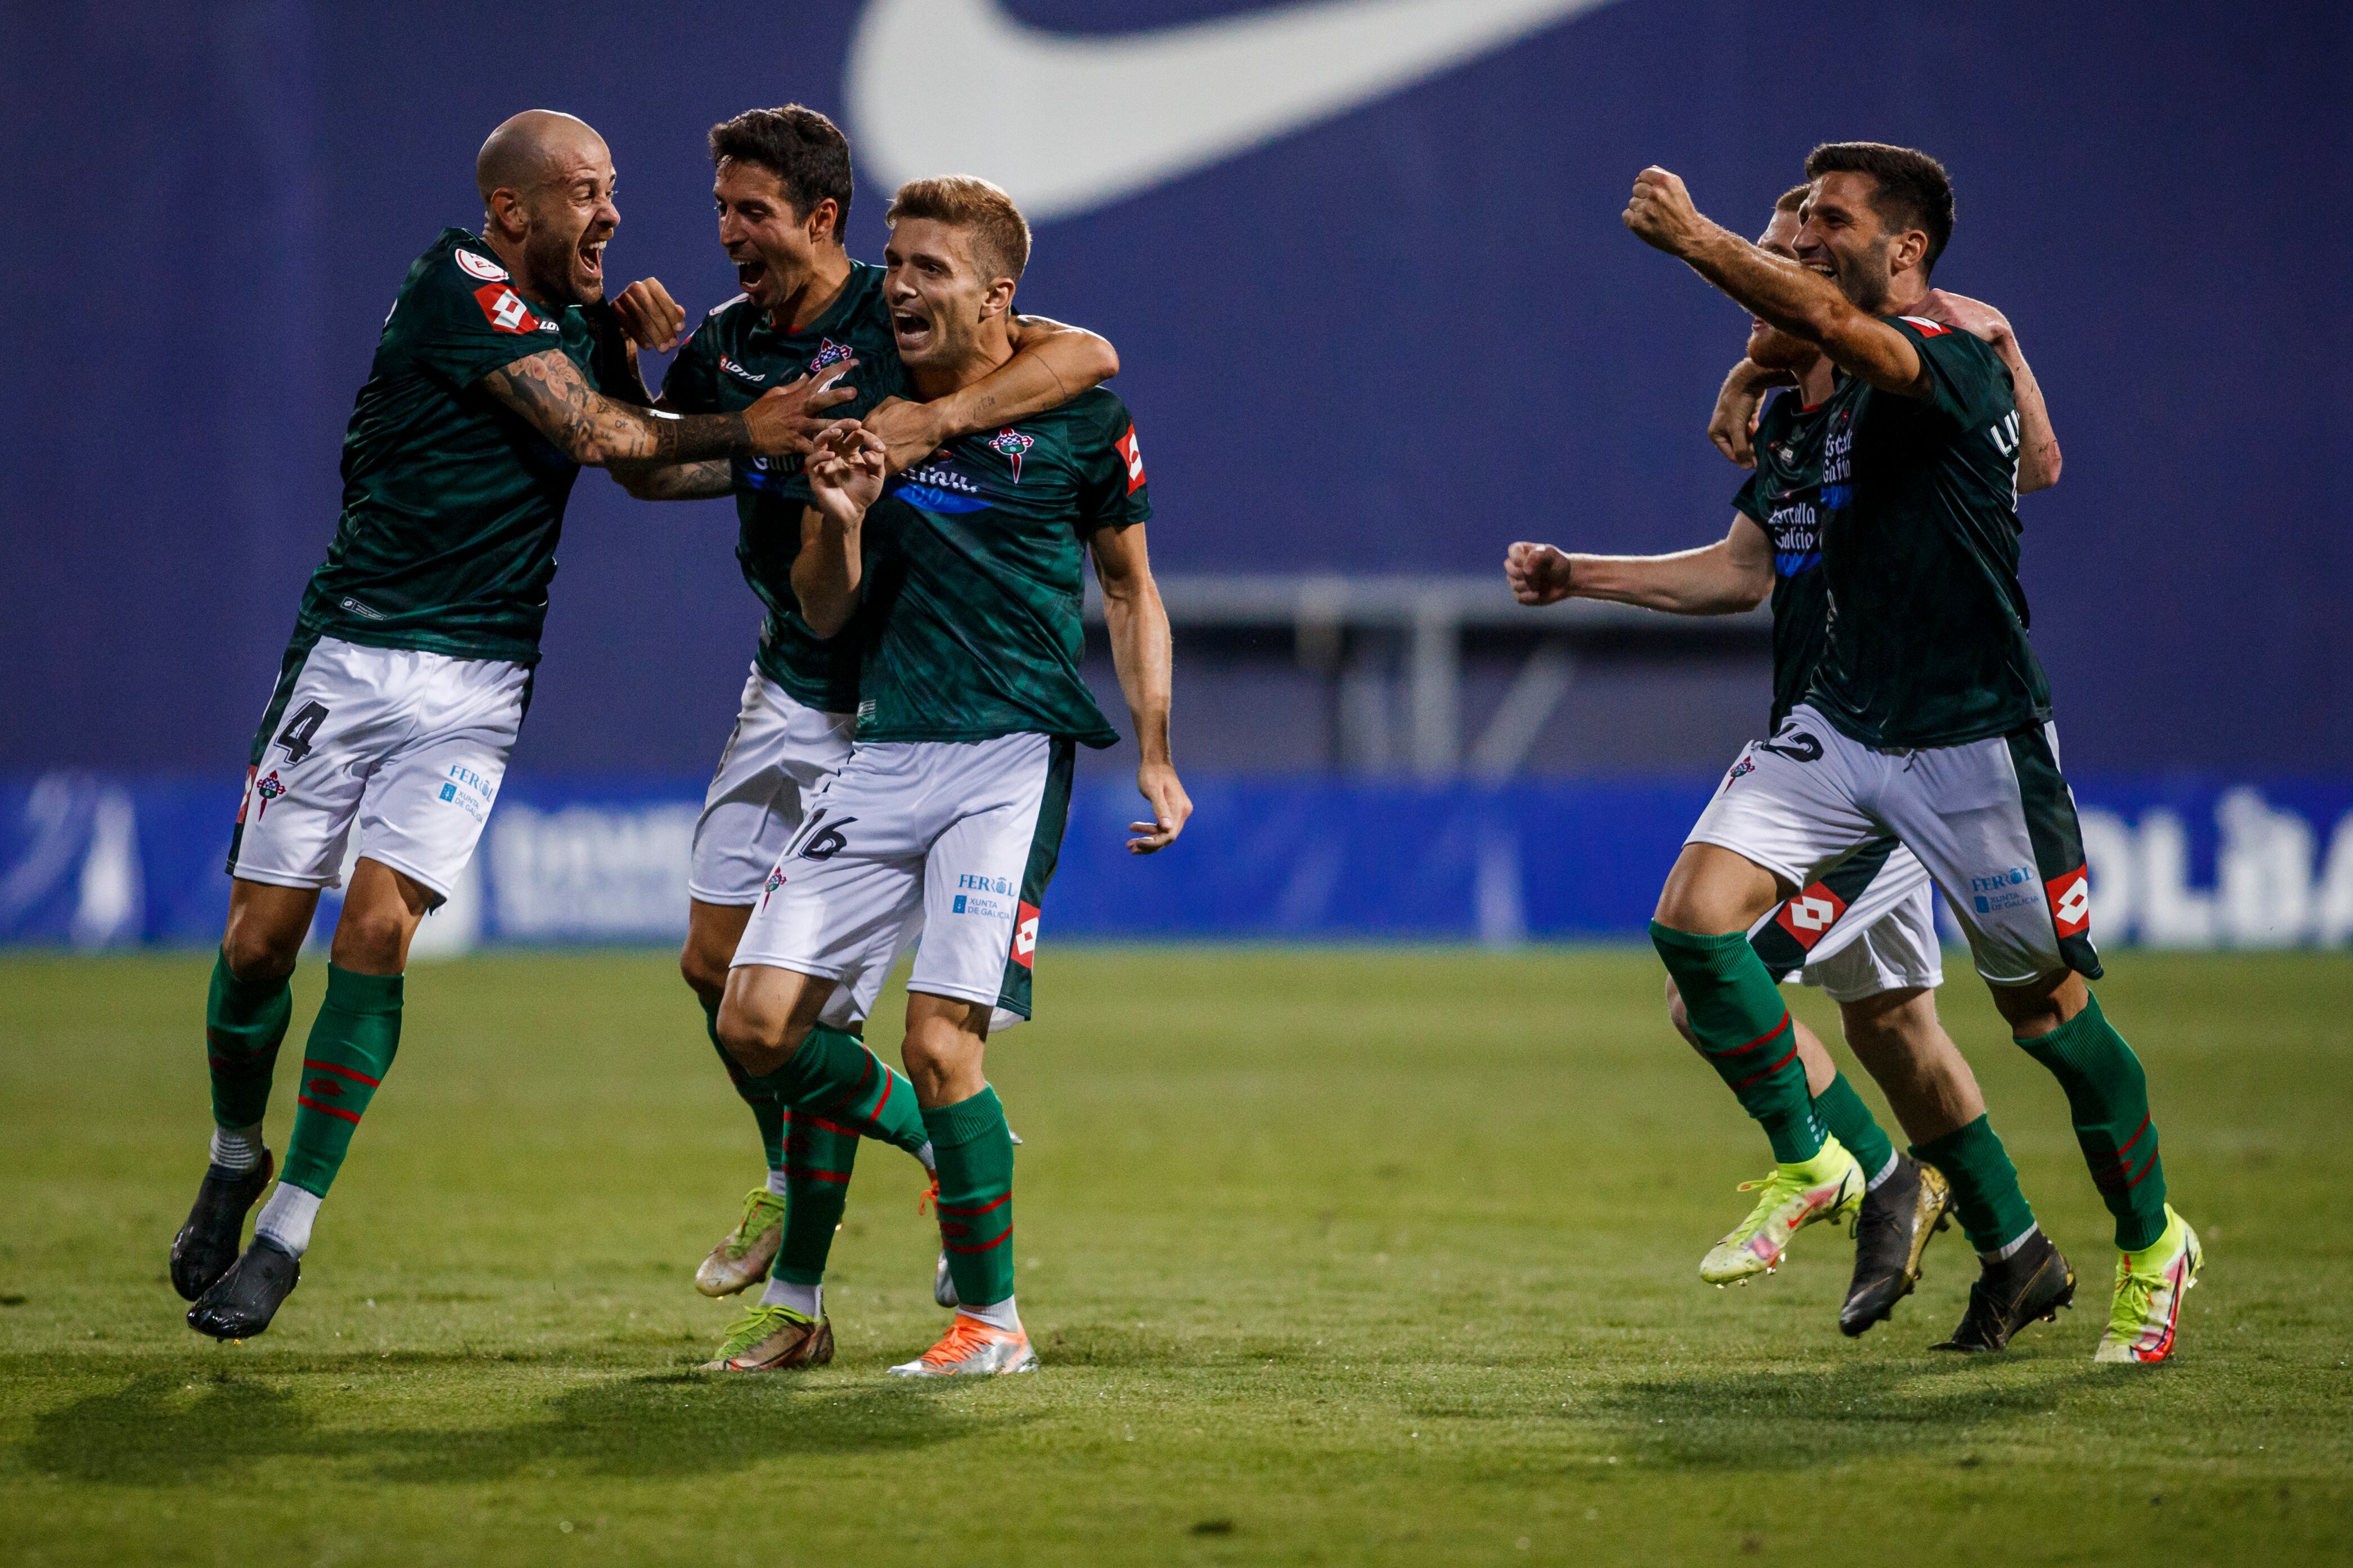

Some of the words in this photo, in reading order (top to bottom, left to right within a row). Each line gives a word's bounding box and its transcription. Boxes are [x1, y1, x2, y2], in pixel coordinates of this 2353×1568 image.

[726, 361, 766, 382] LOTTO
[274, 700, 330, 766] 4
[454, 797, 465, 808] DE
[458, 790, 479, 810] XUNTA
[959, 873, 1014, 897] FERROL
[968, 906, 979, 915] DE
[981, 908, 1010, 920] GALICIA
[969, 898, 998, 909] XUNTA
